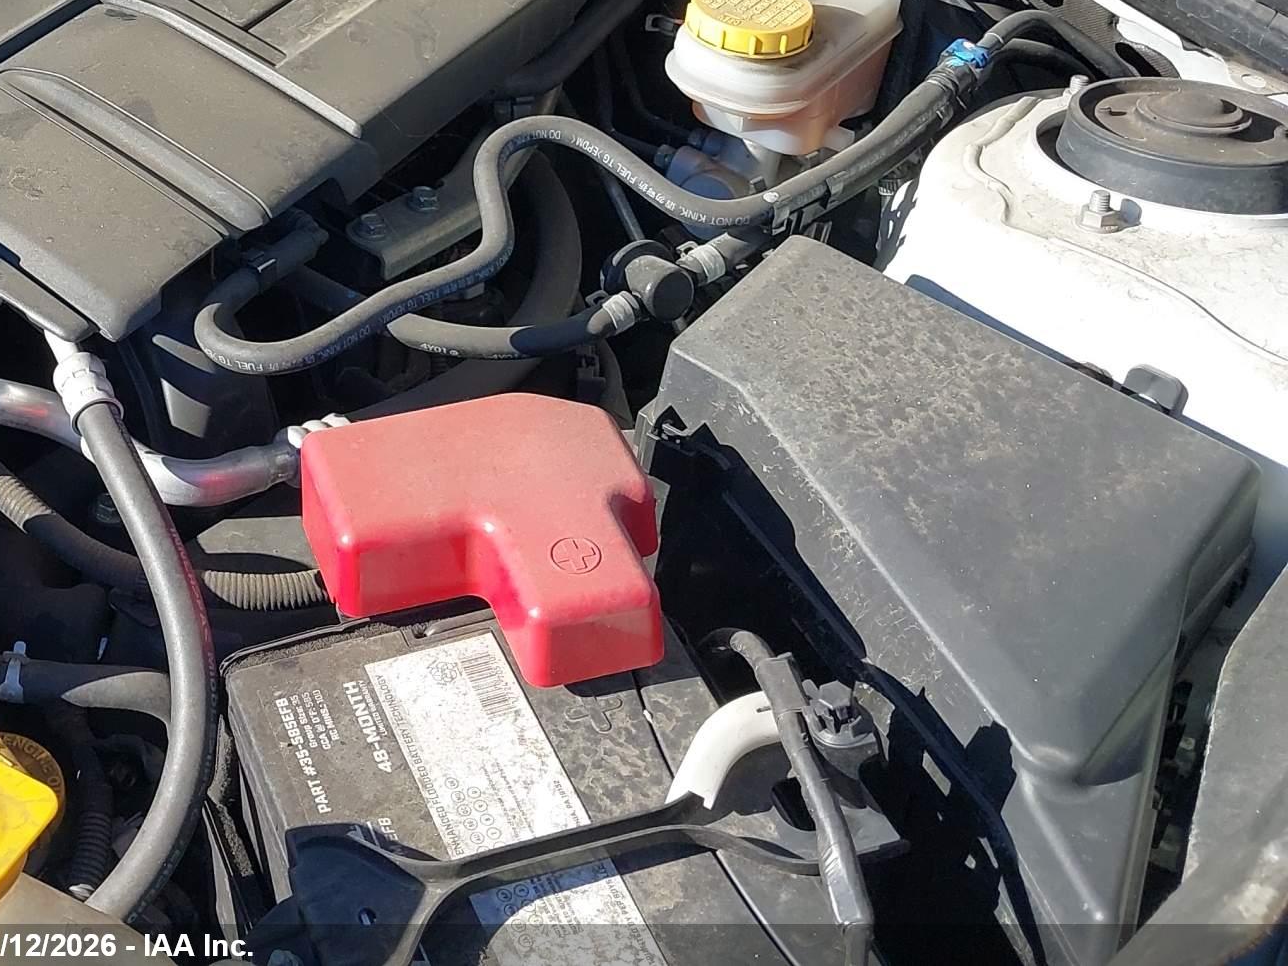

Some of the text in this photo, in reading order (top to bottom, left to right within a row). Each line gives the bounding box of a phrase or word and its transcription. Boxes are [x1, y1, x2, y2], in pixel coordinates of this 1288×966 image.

[600, 152, 616, 167] TG
[613, 162, 638, 184] FUEL
[234, 360, 263, 370] FUEL
[358, 678, 388, 735] LIMITED WARRANTY
[318, 733, 332, 749] CCA
[342, 680, 394, 774] 48-MONTH
[374, 671, 464, 856] ENHANCED FLOODED BATTERY TECHNOLOGY
[306, 778, 332, 814] PART
